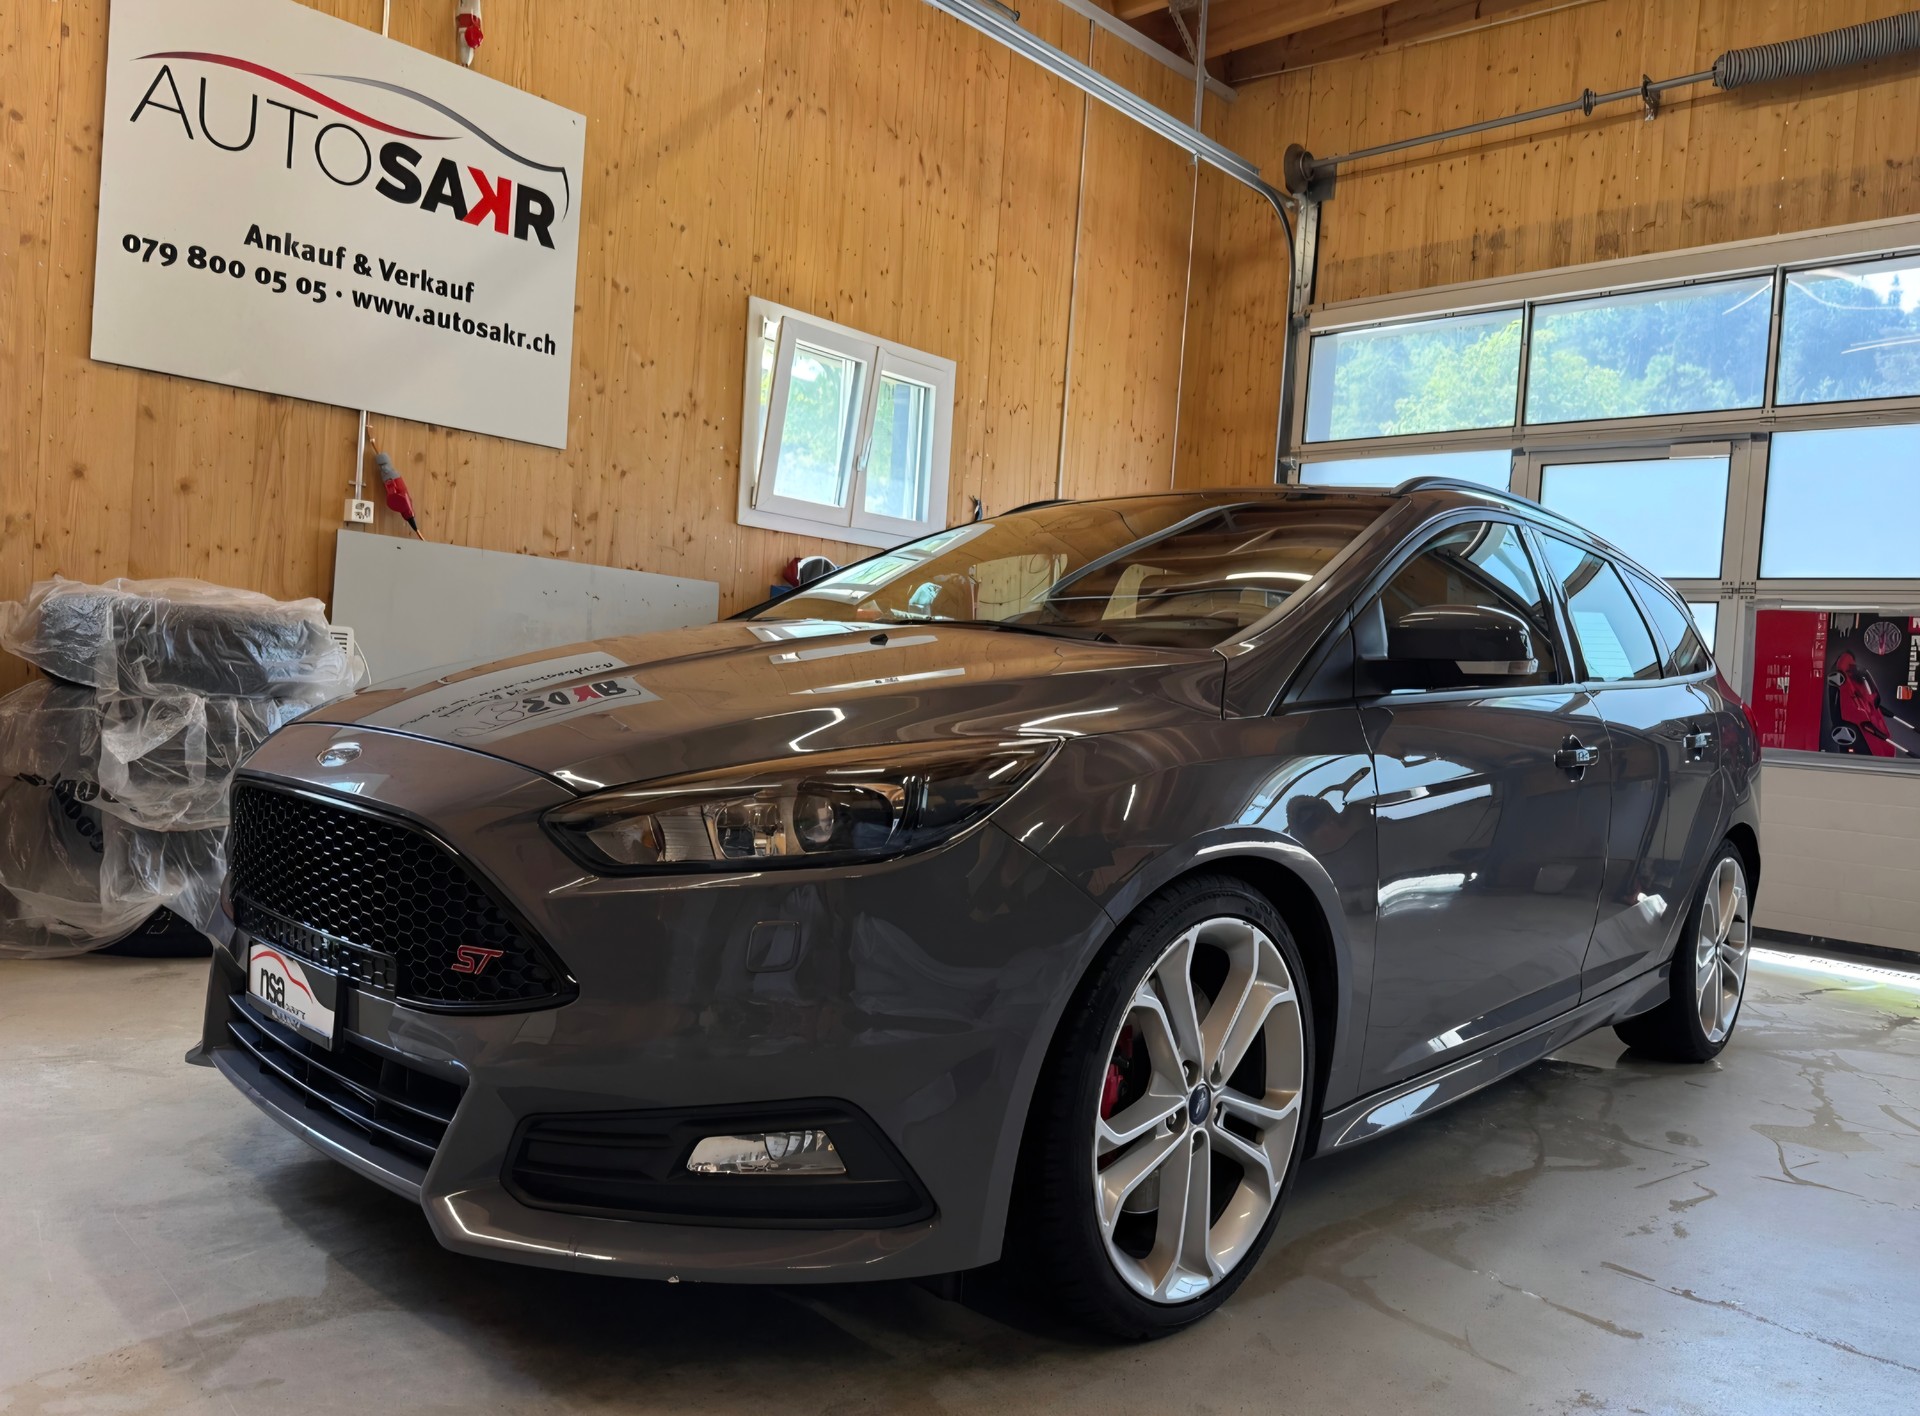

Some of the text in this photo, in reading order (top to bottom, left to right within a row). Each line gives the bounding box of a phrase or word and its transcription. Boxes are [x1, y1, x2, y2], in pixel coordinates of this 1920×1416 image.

[122, 233, 178, 267] 079
[186, 245, 246, 279] 800
[254, 266, 287, 294] 05
[295, 276, 327, 304] 05
[351, 289, 556, 356] www.autosakr.ch
[243, 223, 475, 303] Ankauf & Verkauf
[450, 944, 504, 975] ST
